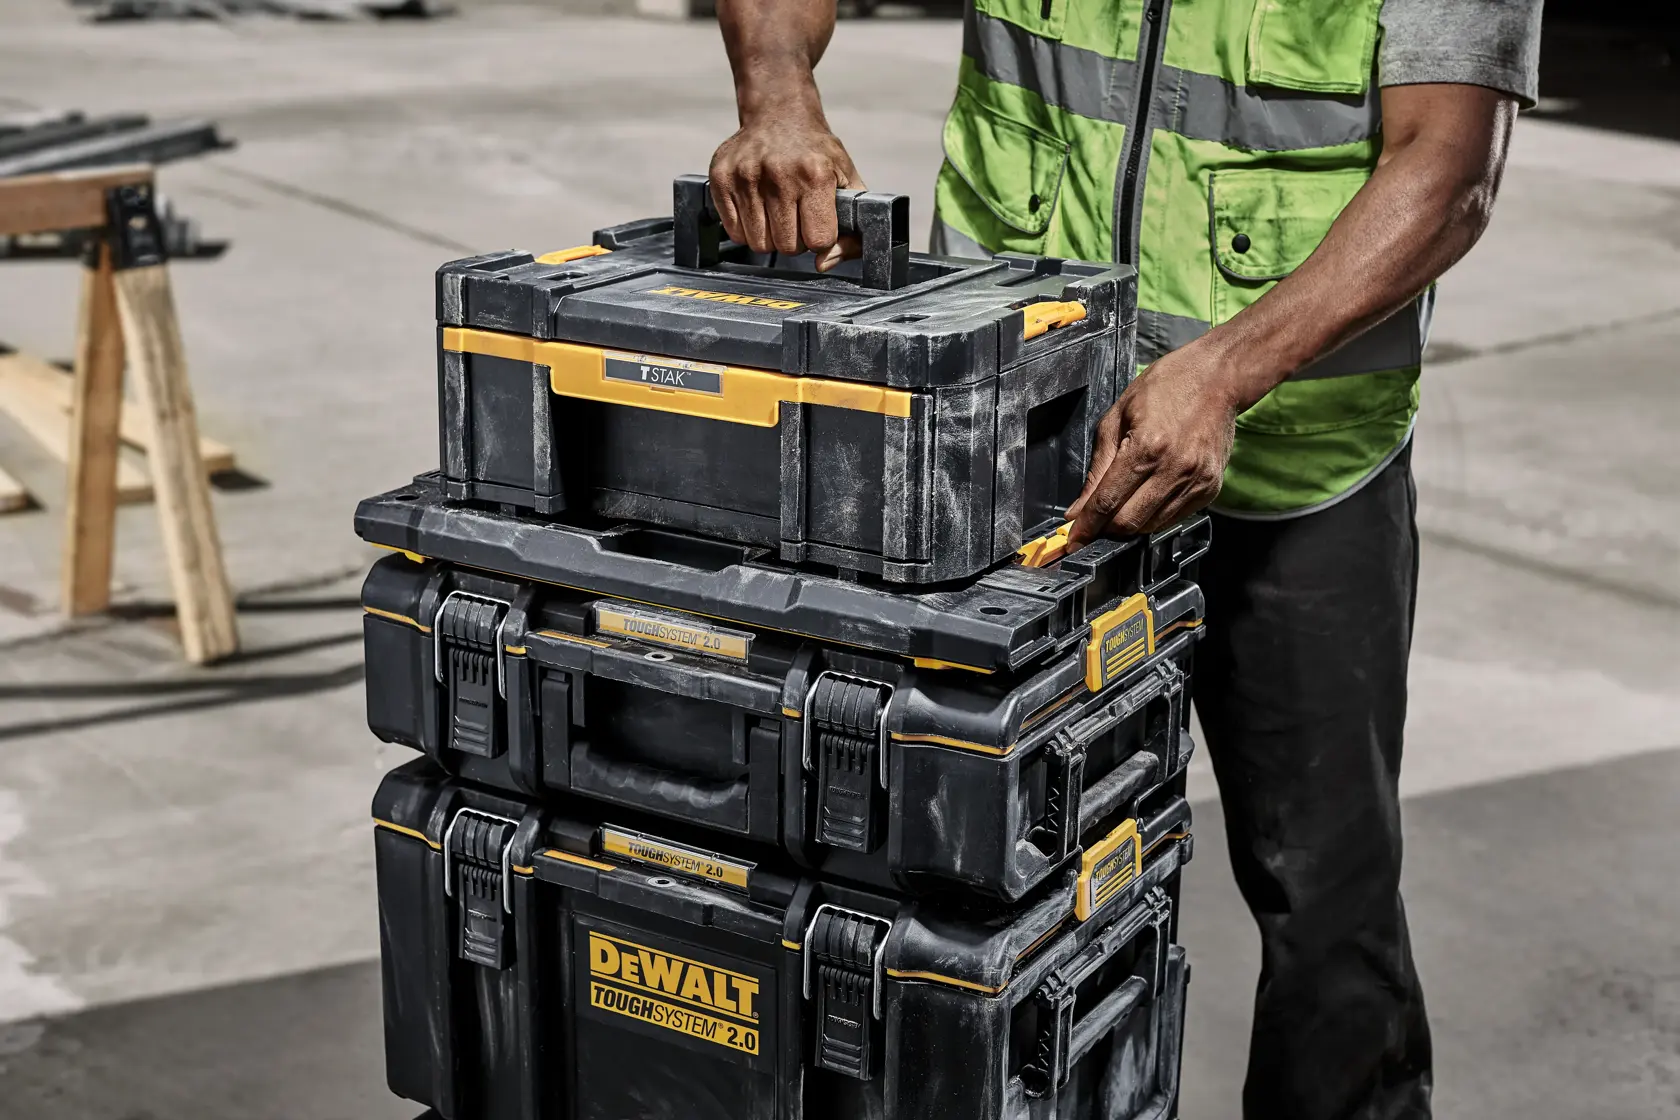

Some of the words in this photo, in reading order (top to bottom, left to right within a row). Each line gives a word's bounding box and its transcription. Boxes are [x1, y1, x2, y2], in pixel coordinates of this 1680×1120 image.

[650, 287, 805, 310] DEWALT
[703, 635, 721, 650] 2.0
[705, 863, 723, 878] 2.0
[727, 1026, 756, 1051] 2.0
